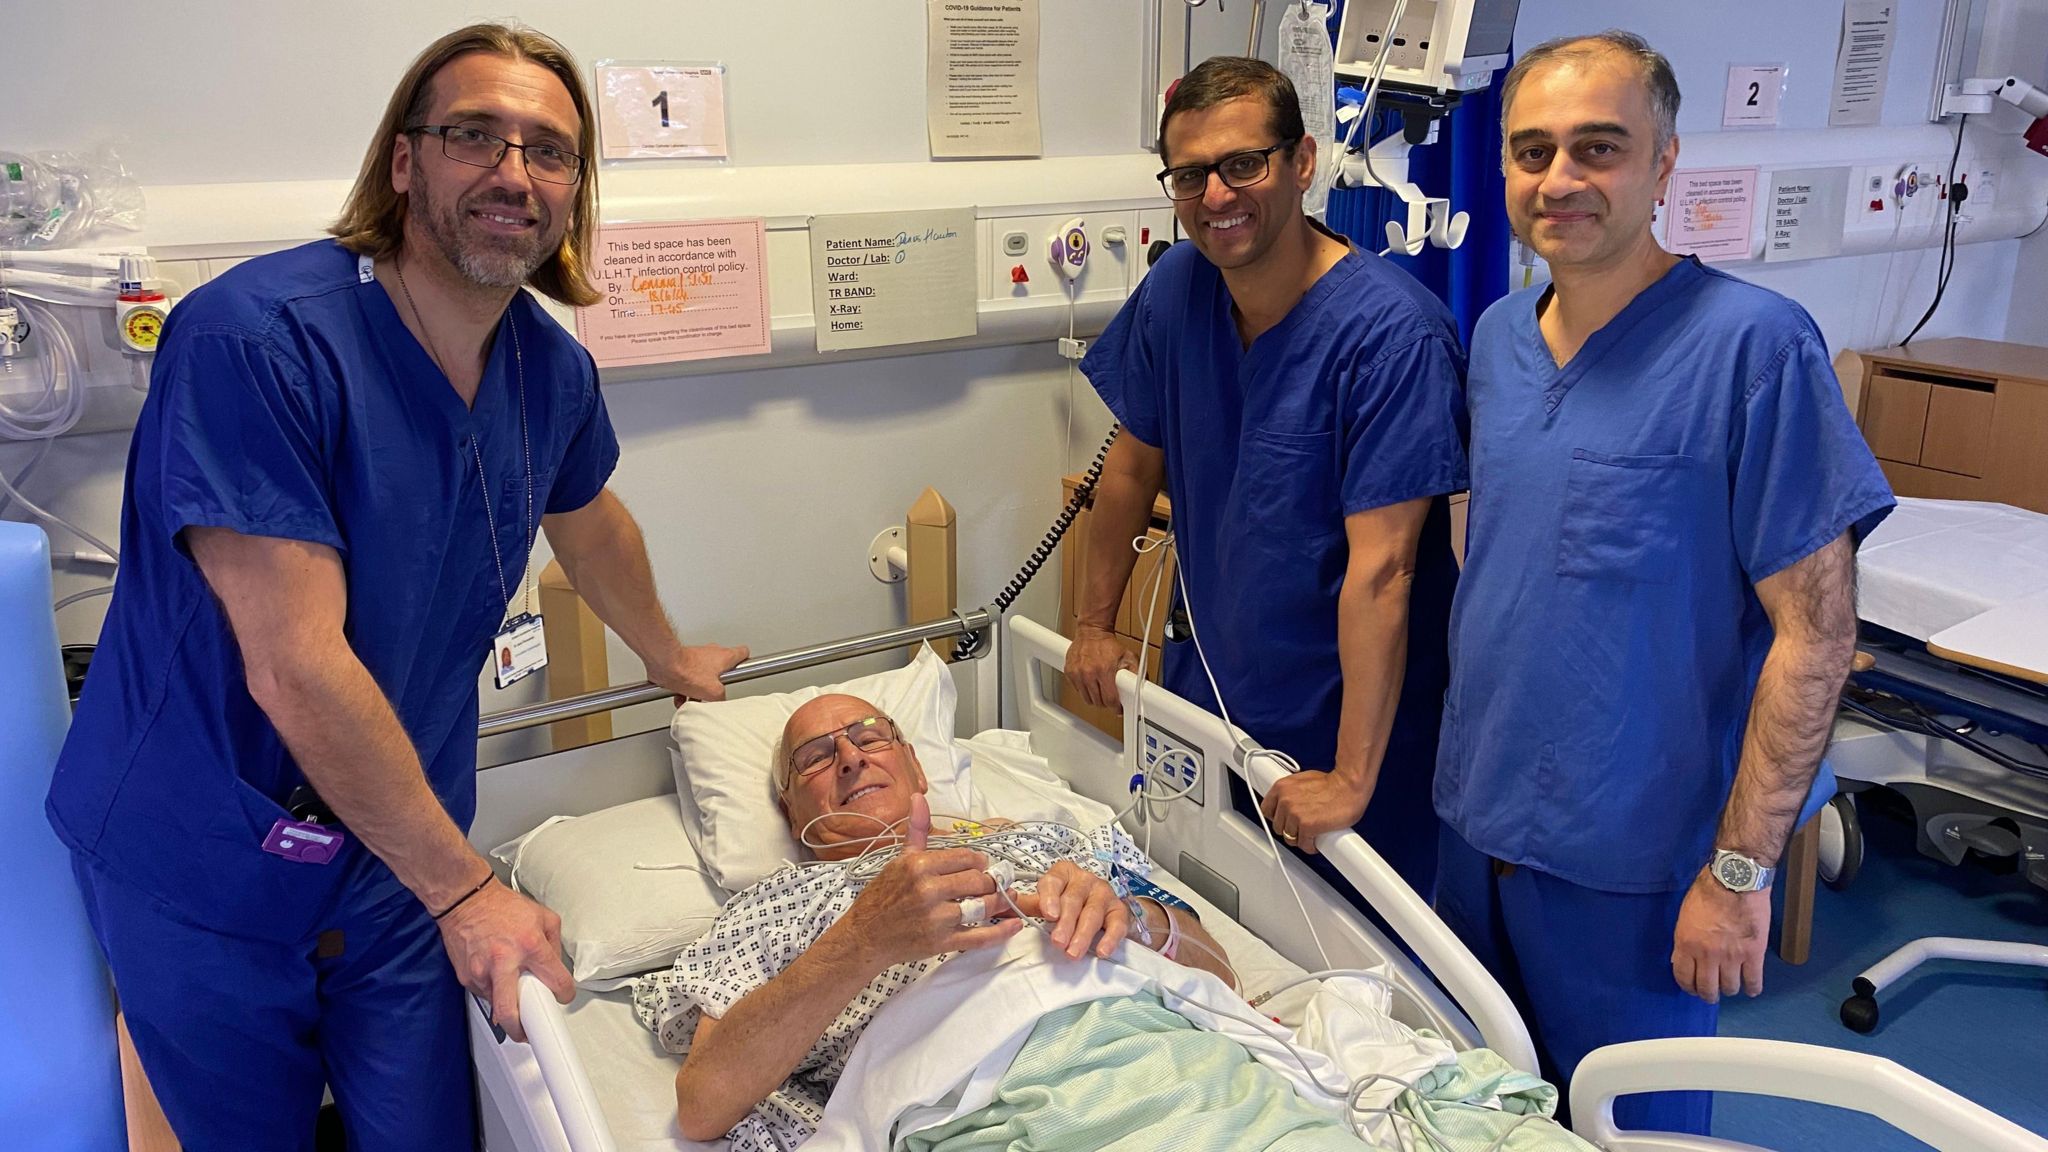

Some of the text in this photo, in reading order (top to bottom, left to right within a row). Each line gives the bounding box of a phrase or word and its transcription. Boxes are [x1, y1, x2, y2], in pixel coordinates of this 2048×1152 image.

[1746, 82, 1760, 106] 2
[652, 90, 669, 128] 1
[608, 236, 731, 252] This bed space has been
[826, 238, 895, 250] Patient Name:
[604, 248, 737, 266] cleaned in accordance with
[827, 255, 861, 267] Doctor
[870, 253, 890, 264] Lab:
[638, 264, 680, 277] infection
[682, 261, 715, 275] control
[718, 260, 748, 273] policy.
[828, 271, 859, 282] Ward:
[828, 286, 876, 298] TR BAND:
[830, 304, 861, 315] X-Ray:
[831, 320, 863, 331] Home:
